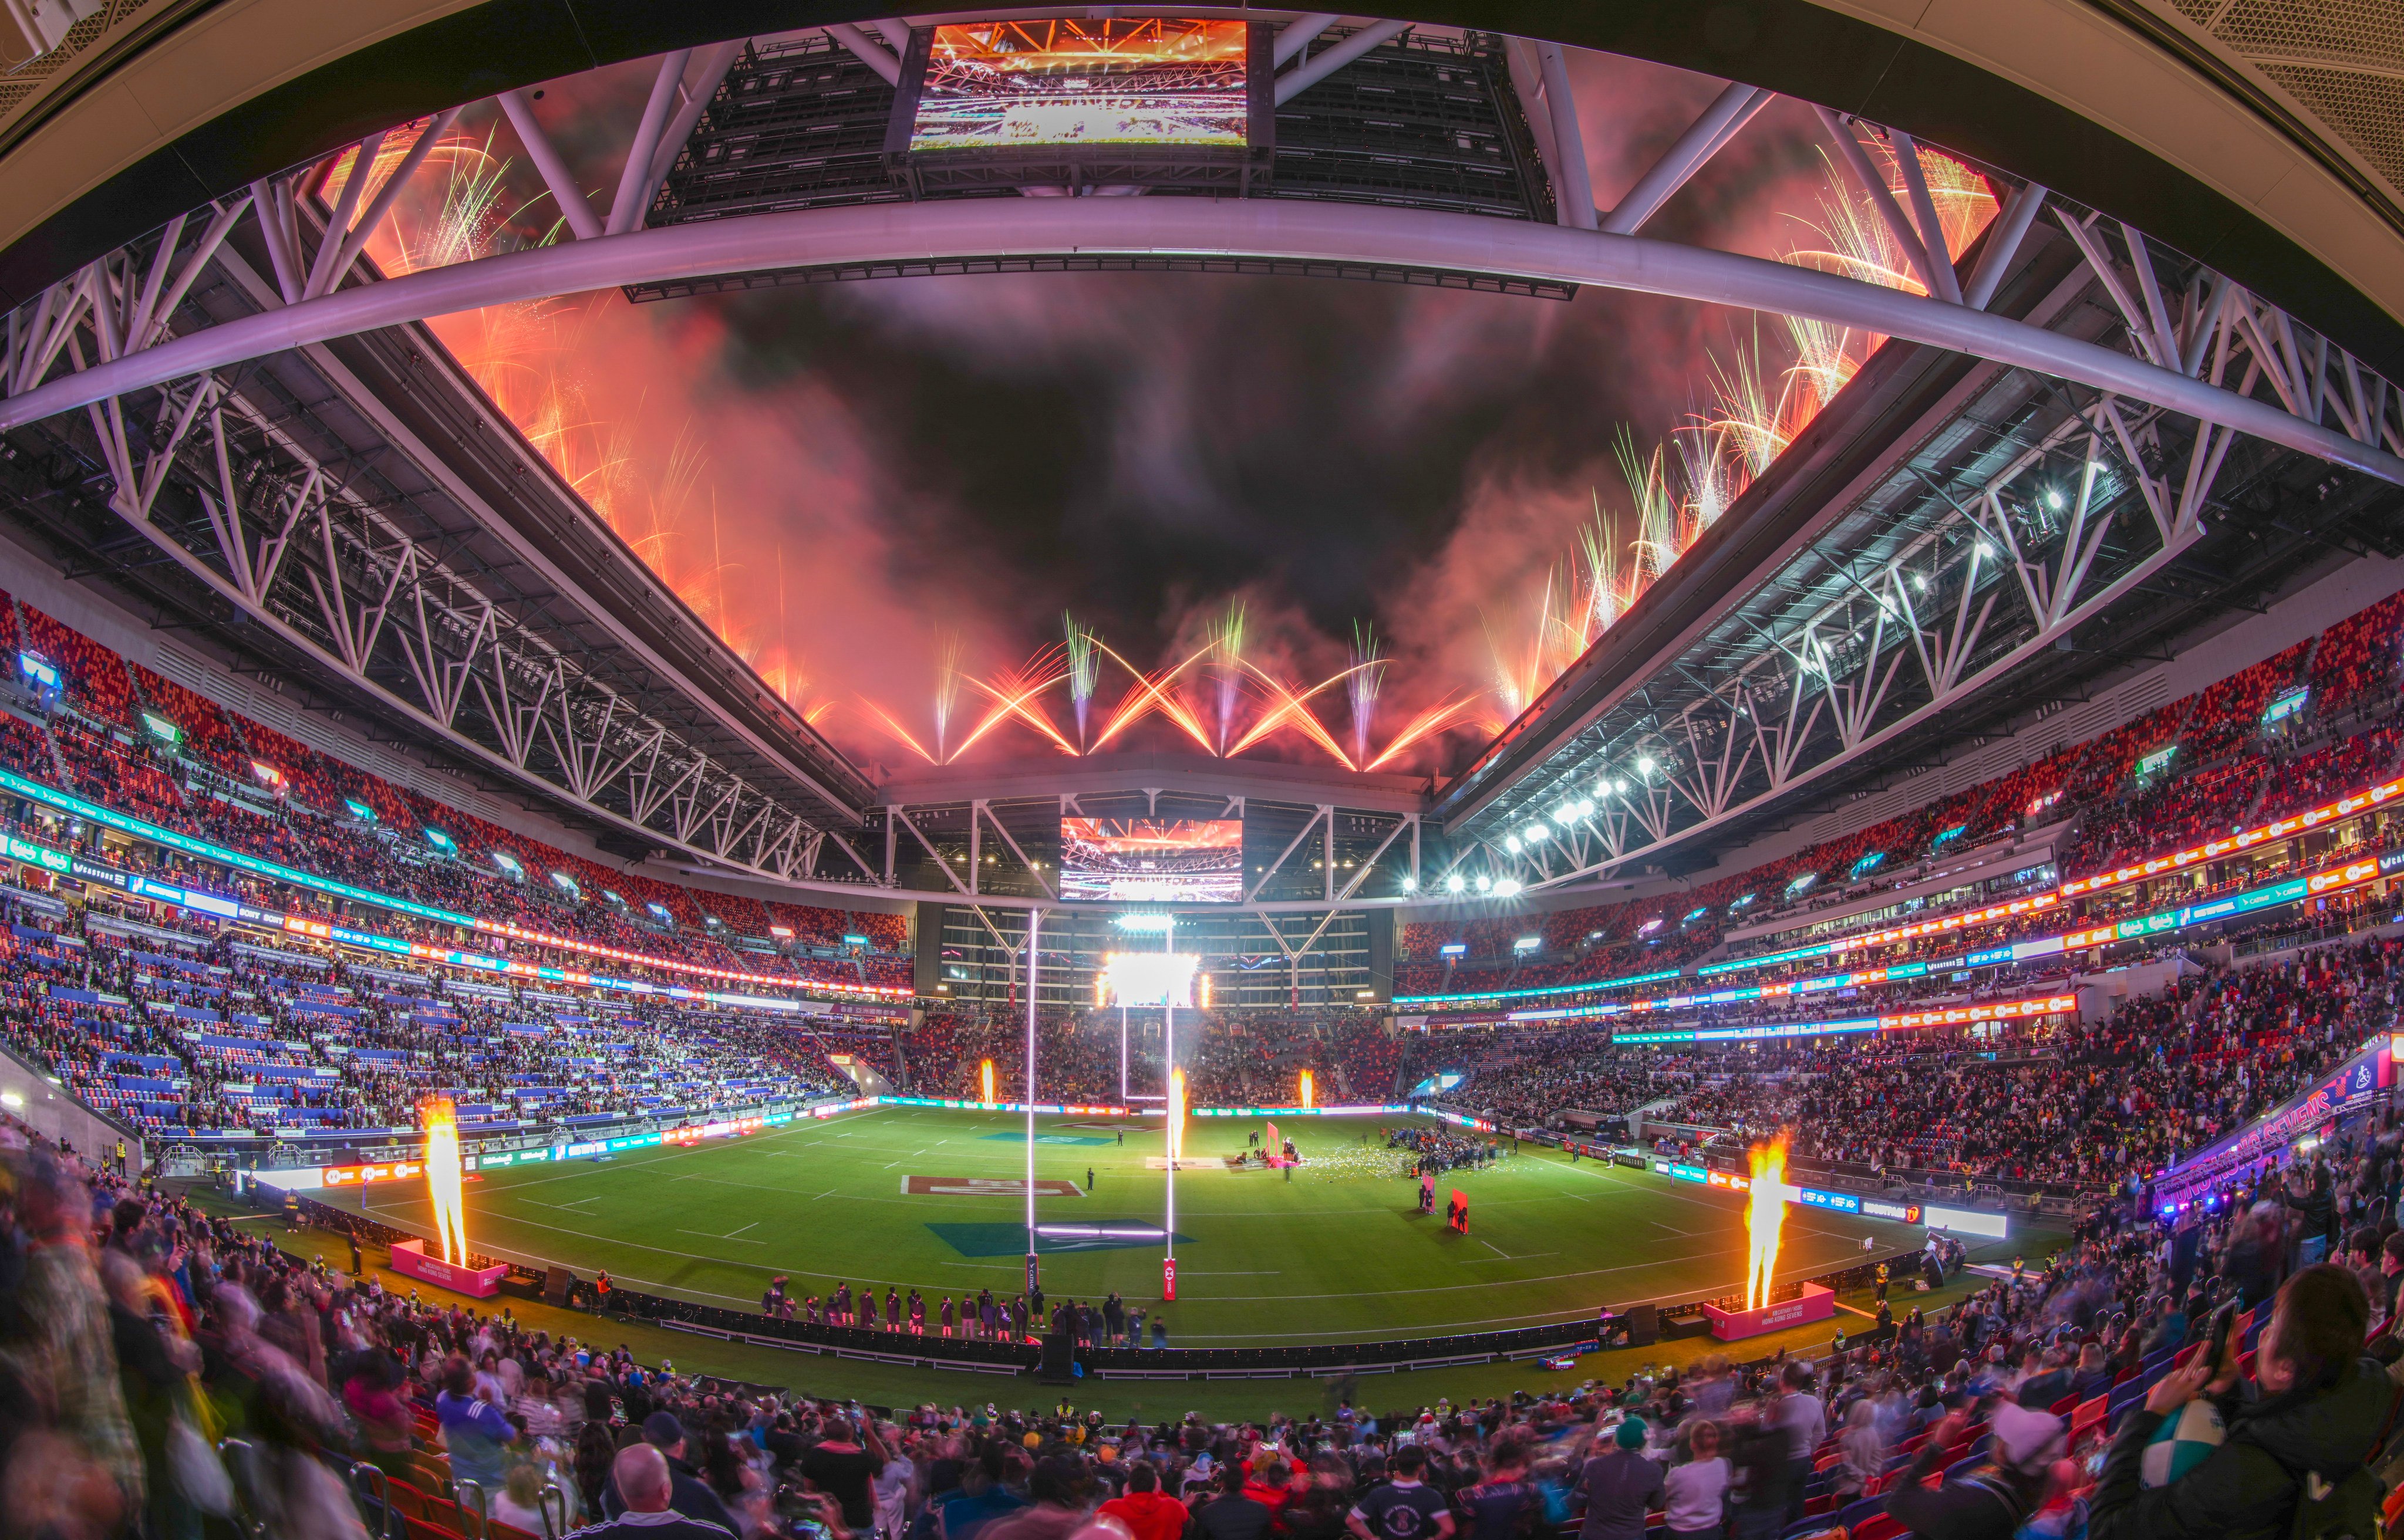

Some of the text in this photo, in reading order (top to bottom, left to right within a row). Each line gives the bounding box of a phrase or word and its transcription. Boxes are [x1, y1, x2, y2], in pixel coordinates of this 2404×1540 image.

[239, 909, 284, 924] SONY SONY
[1623, 1157, 1643, 1167] CASTORE
[1907, 1207, 1919, 1220] TV
[417, 1265, 452, 1281] HONG KONG SEVENS
[1762, 1317, 1774, 1325] HONG
[1786, 1311, 1803, 1319] SEVENS
